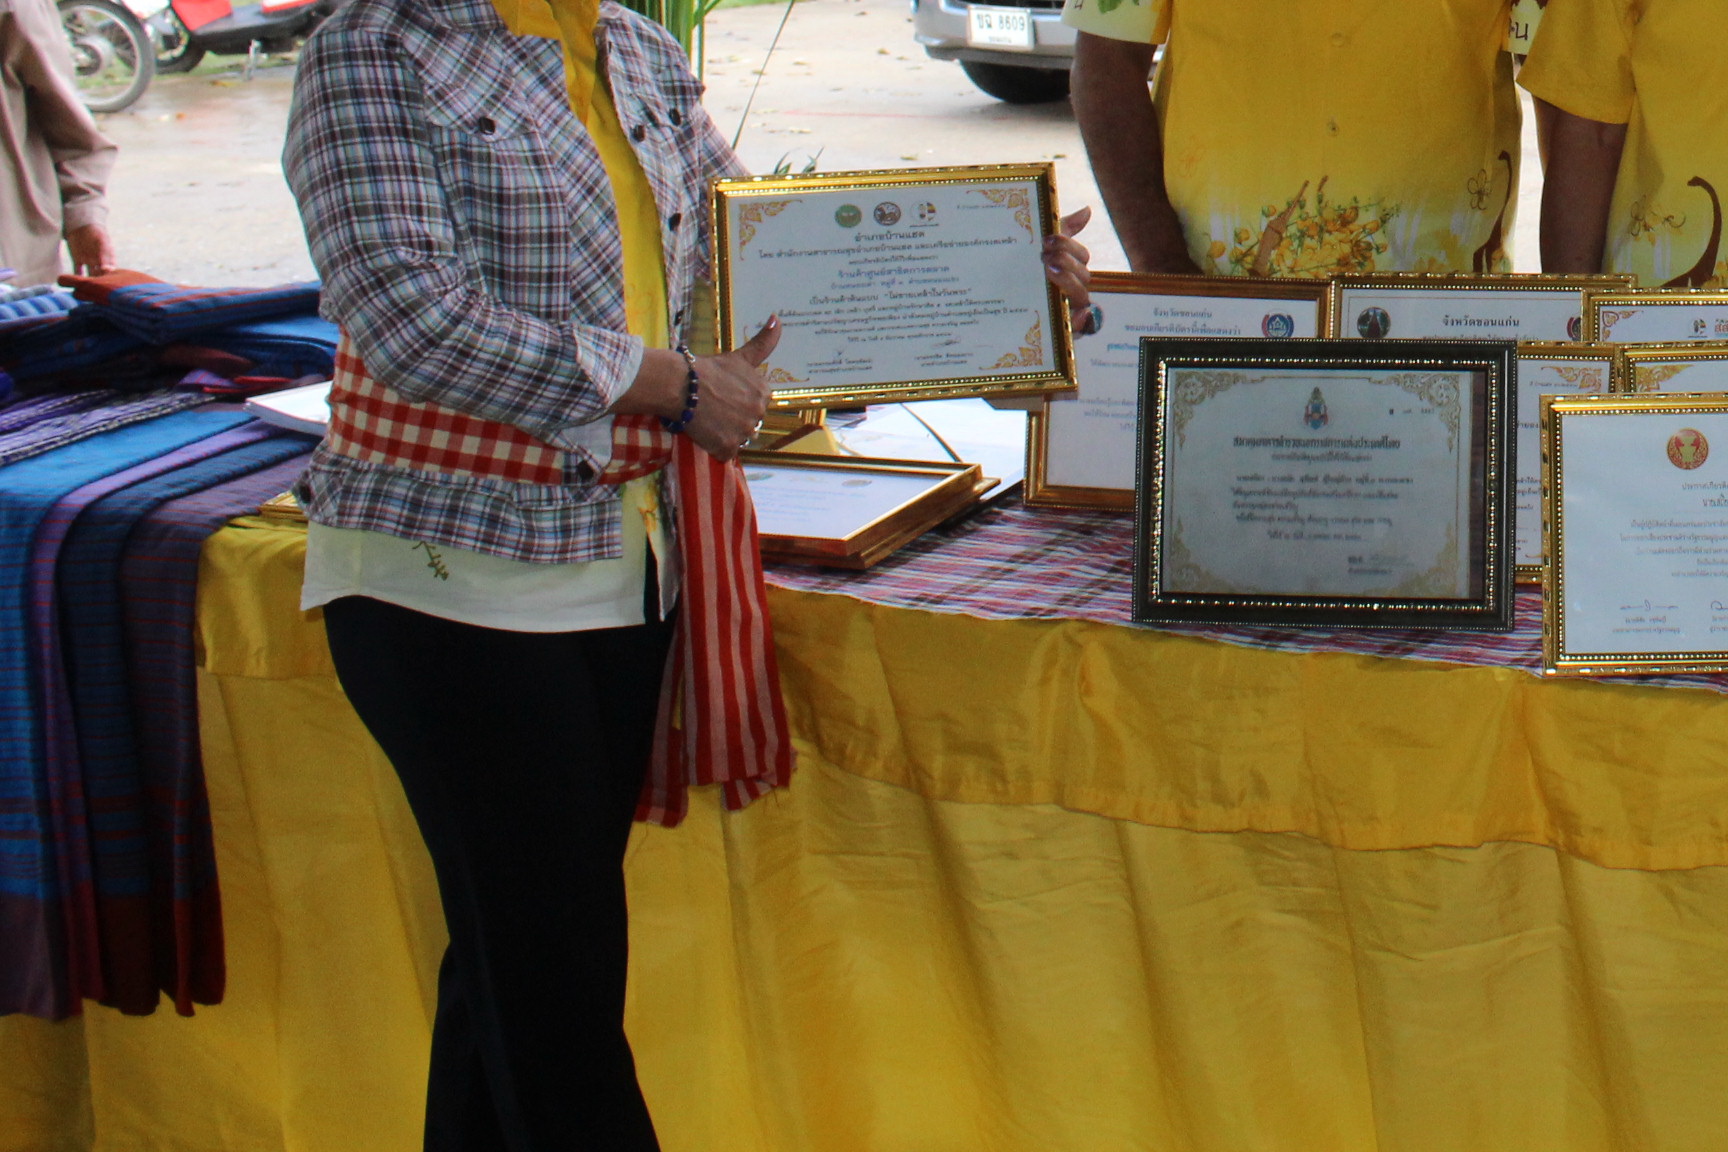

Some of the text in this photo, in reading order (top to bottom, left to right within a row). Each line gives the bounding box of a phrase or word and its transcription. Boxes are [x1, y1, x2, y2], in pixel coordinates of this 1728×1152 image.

[1442, 314, 1520, 327] จังหวัดขอนแก่น
